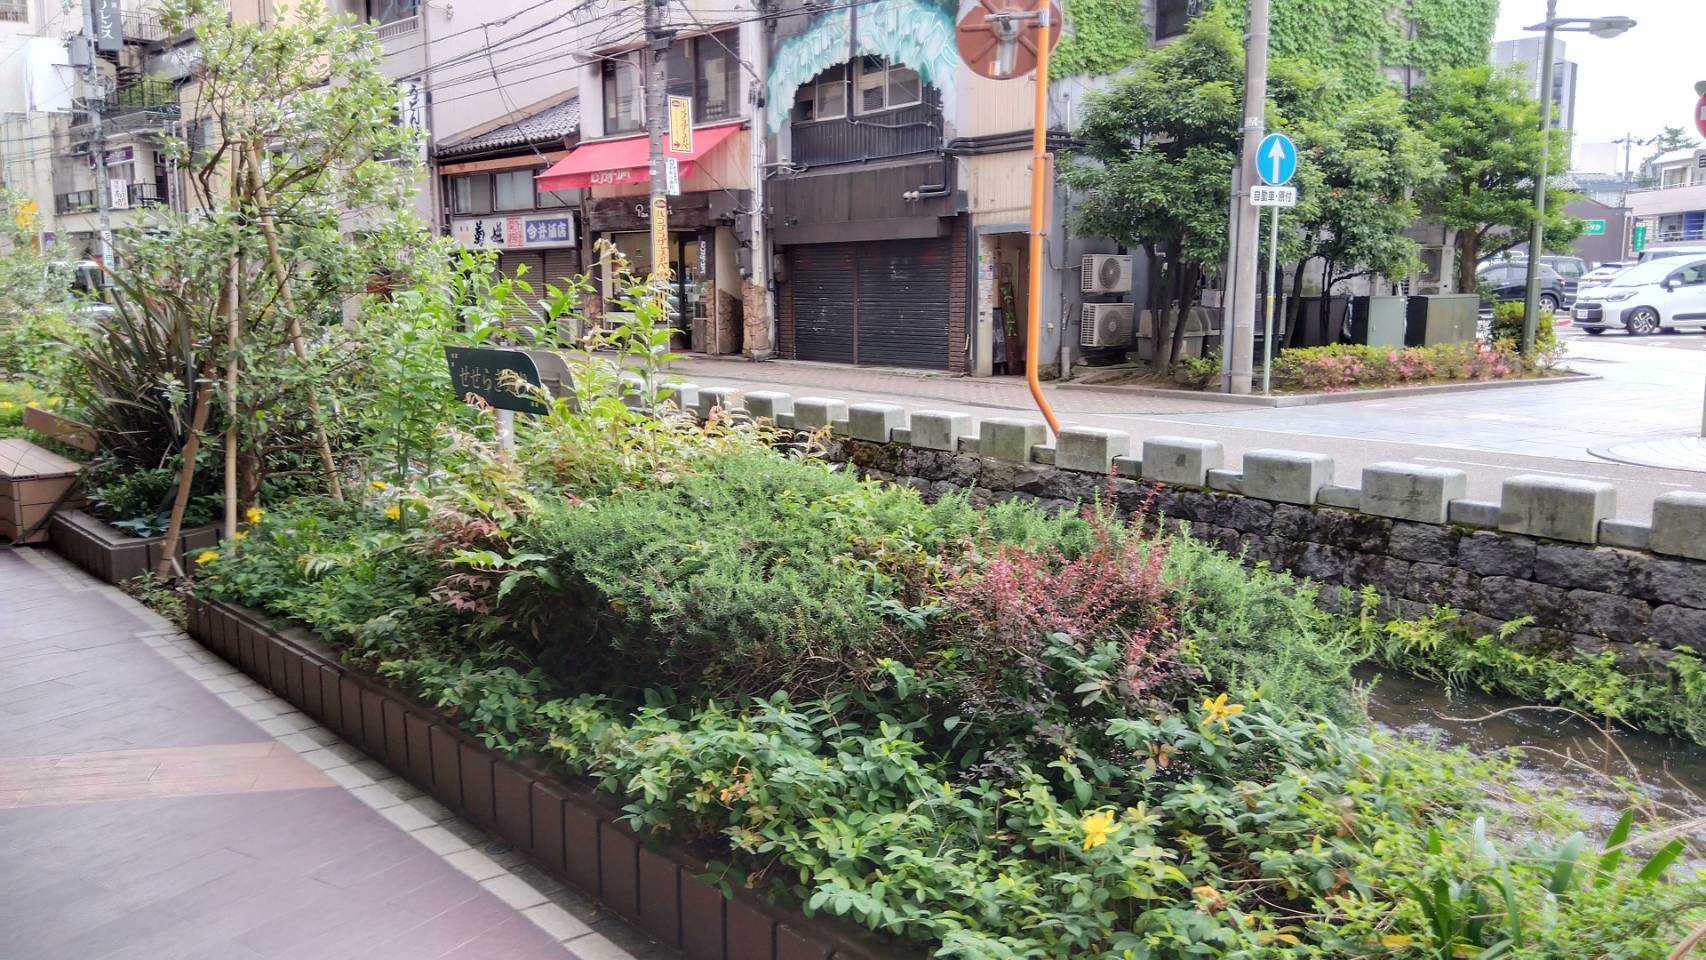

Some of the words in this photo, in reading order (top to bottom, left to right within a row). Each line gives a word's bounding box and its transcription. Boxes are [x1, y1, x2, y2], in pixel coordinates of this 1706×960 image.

[1254, 190, 1292, 203] 自動車・原付
[527, 221, 568, 241] 今井酒店
